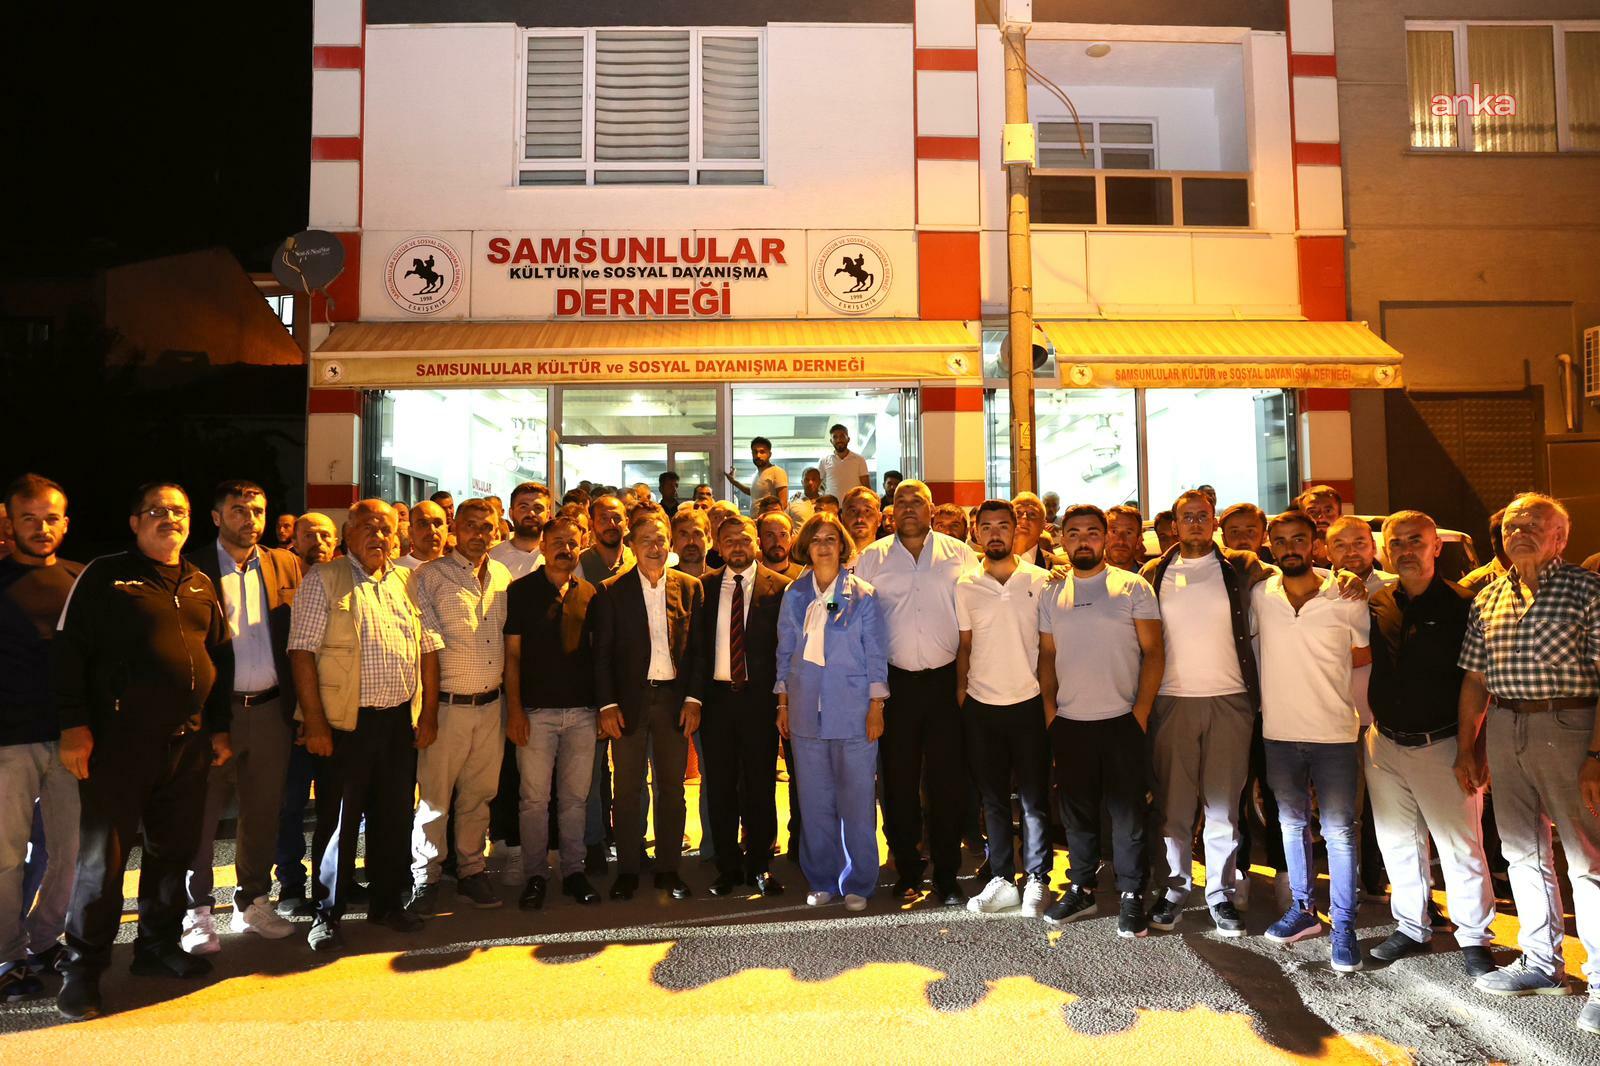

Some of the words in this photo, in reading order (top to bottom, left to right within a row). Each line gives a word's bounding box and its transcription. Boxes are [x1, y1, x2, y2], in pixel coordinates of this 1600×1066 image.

[487, 237, 787, 264] SAMSUNLULAR
[510, 265, 580, 279] KÜLTÜR
[582, 269, 600, 279] ve
[603, 266, 668, 279] SOSYAL
[672, 266, 768, 280] DAYANIŞMA
[556, 281, 731, 316] DERNEĞİ
[416, 362, 532, 376] SAMSUNLULAR
[537, 359, 601, 374] KÜLTÜR
[606, 364, 624, 373] ve
[628, 360, 690, 373] SOSYAL
[695, 359, 788, 375] DAYANIŞMA
[792, 357, 865, 372] DERNEĞİ
[1115, 368, 1180, 381] SAMSUNLULAR
[1181, 365, 1216, 380] KÜLTÜR
[1217, 370, 1228, 380] ve
[1229, 368, 1262, 380] SOSYAL
